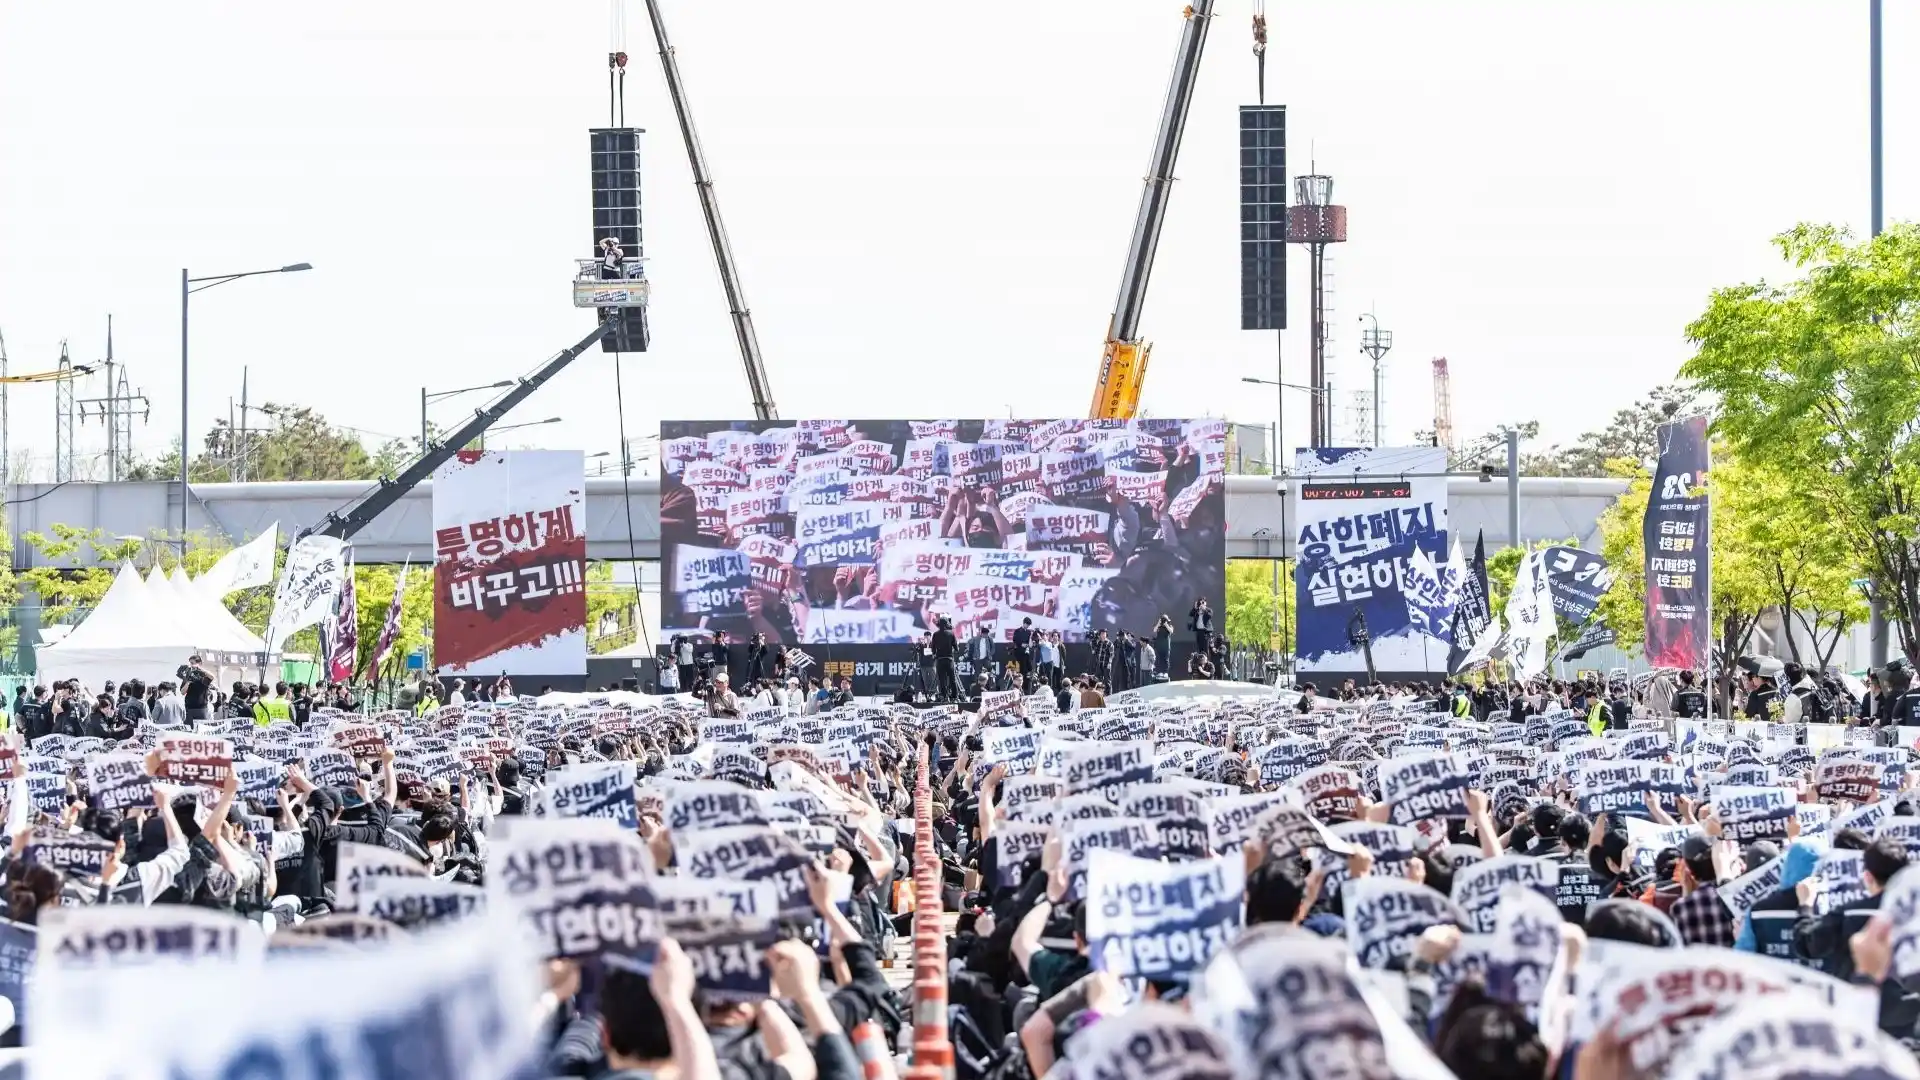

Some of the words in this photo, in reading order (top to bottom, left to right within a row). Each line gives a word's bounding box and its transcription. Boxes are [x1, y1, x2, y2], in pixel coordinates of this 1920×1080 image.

[1047, 453, 1098, 477] 투명하게
[730, 497, 781, 517] 투명하게
[436, 504, 577, 564] 투명하게
[801, 509, 871, 537] 상한폐지
[1031, 514, 1099, 537] 투명하게
[1297, 501, 1437, 560] 상한폐지
[450, 559, 583, 611] 바꾸고!!!
[954, 584, 1031, 612] 투명하게
[823, 661, 884, 677] 투명하게
[984, 693, 1016, 707] 투명하게
[703, 725, 747, 738] 상한폐지
[828, 723, 867, 741] 상한폐지
[1409, 730, 1444, 741] 상한폐지
[162, 740, 225, 756] 투명하게
[1564, 744, 1608, 767] 상한폐지
[1067, 747, 1142, 784] 상한폐지
[1386, 757, 1457, 797] 상한폐지
[1483, 768, 1530, 784] 상한폐지
[1584, 765, 1642, 789] 상한폐지
[552, 769, 623, 809] 상한폐지
[1716, 791, 1785, 818] 상한폐지
[1101, 864, 1227, 918] 상한폐지
